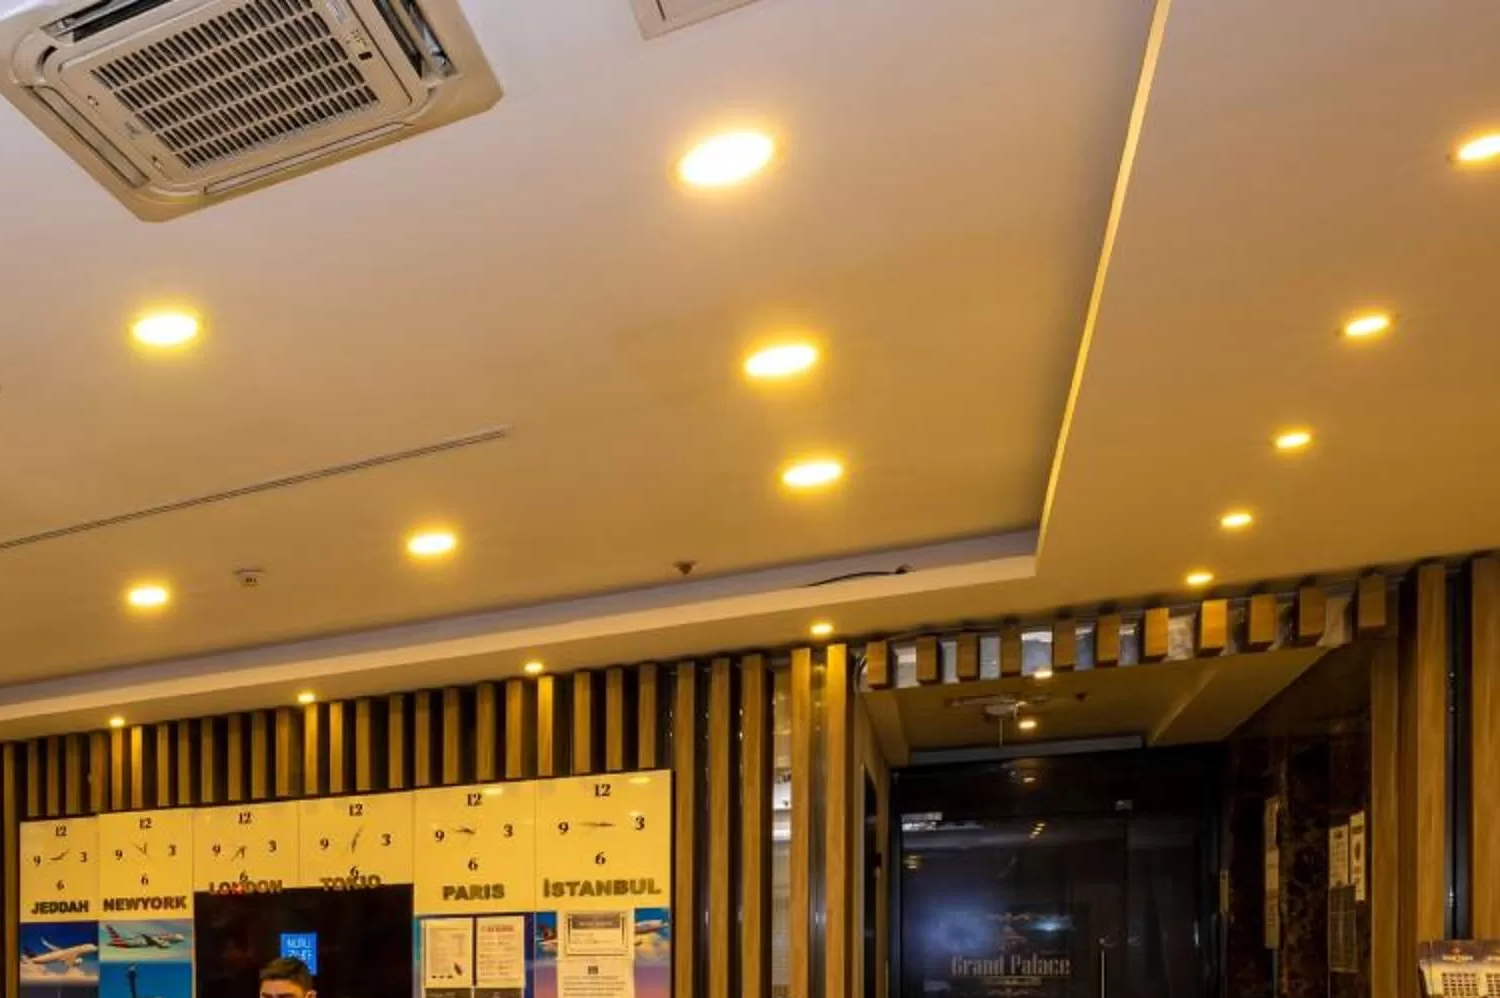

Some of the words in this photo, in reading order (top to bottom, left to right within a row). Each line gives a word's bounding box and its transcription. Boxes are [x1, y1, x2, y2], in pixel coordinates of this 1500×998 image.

[594, 784, 611, 797] 12
[467, 794, 482, 806] 12
[349, 804, 363, 816] 12
[140, 818, 152, 829] 12
[238, 812, 251, 824] 12
[635, 816, 645, 830] 3
[55, 826, 67, 837] 12
[504, 824, 514, 837] 3
[558, 821, 569, 834] 9
[381, 833, 391, 846] 3
[435, 829, 445, 842] 9
[268, 840, 277, 852] 3
[320, 837, 330, 849] 9
[468, 857, 478, 870] 6
[595, 852, 606, 865] 6
[209, 880, 283, 895] LONDON
[442, 884, 505, 900] PARIS
[543, 878, 661, 898] İSTANBUL
[31, 900, 89, 915] JEDDAH
[103, 896, 187, 912] NEWYORK
[951, 955, 1004, 976] Grand
[1011, 952, 1071, 976] Palace
